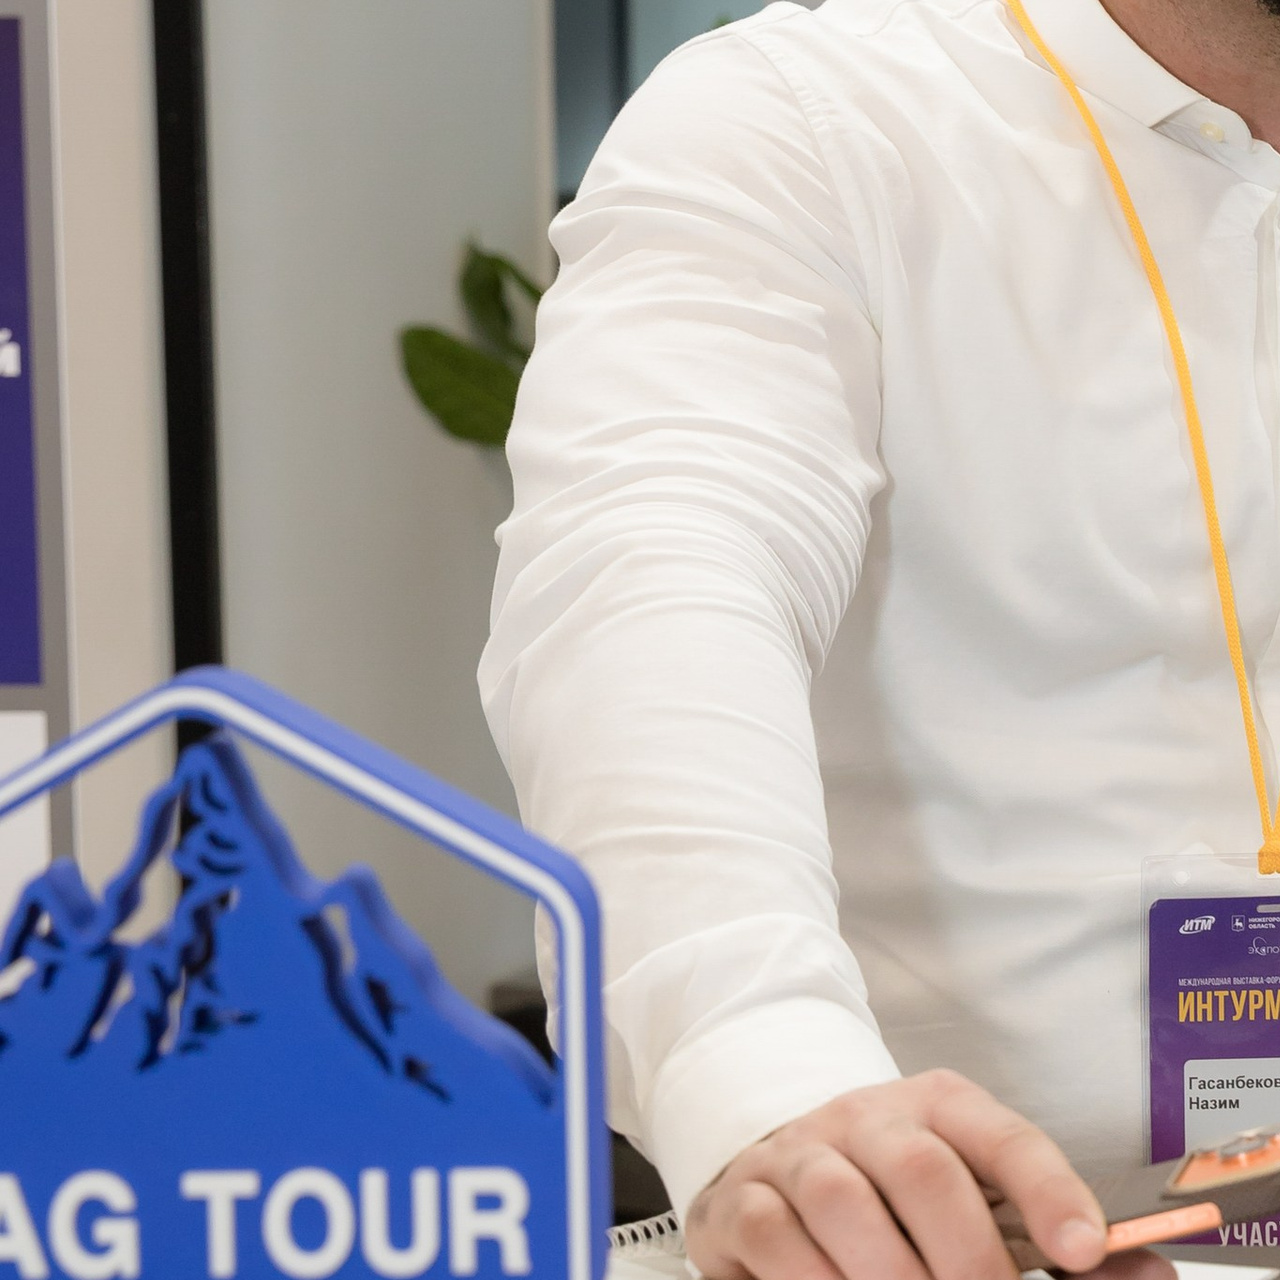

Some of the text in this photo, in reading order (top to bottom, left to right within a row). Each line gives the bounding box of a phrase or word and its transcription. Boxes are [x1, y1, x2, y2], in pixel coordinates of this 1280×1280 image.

[1184, 919, 1213, 931] ИТМ
[1178, 977, 1232, 987] МЕЖДУНАРОДНАЯ
[1188, 1097, 1240, 1110] Назим
[179, 1166, 532, 1280] TOUR
